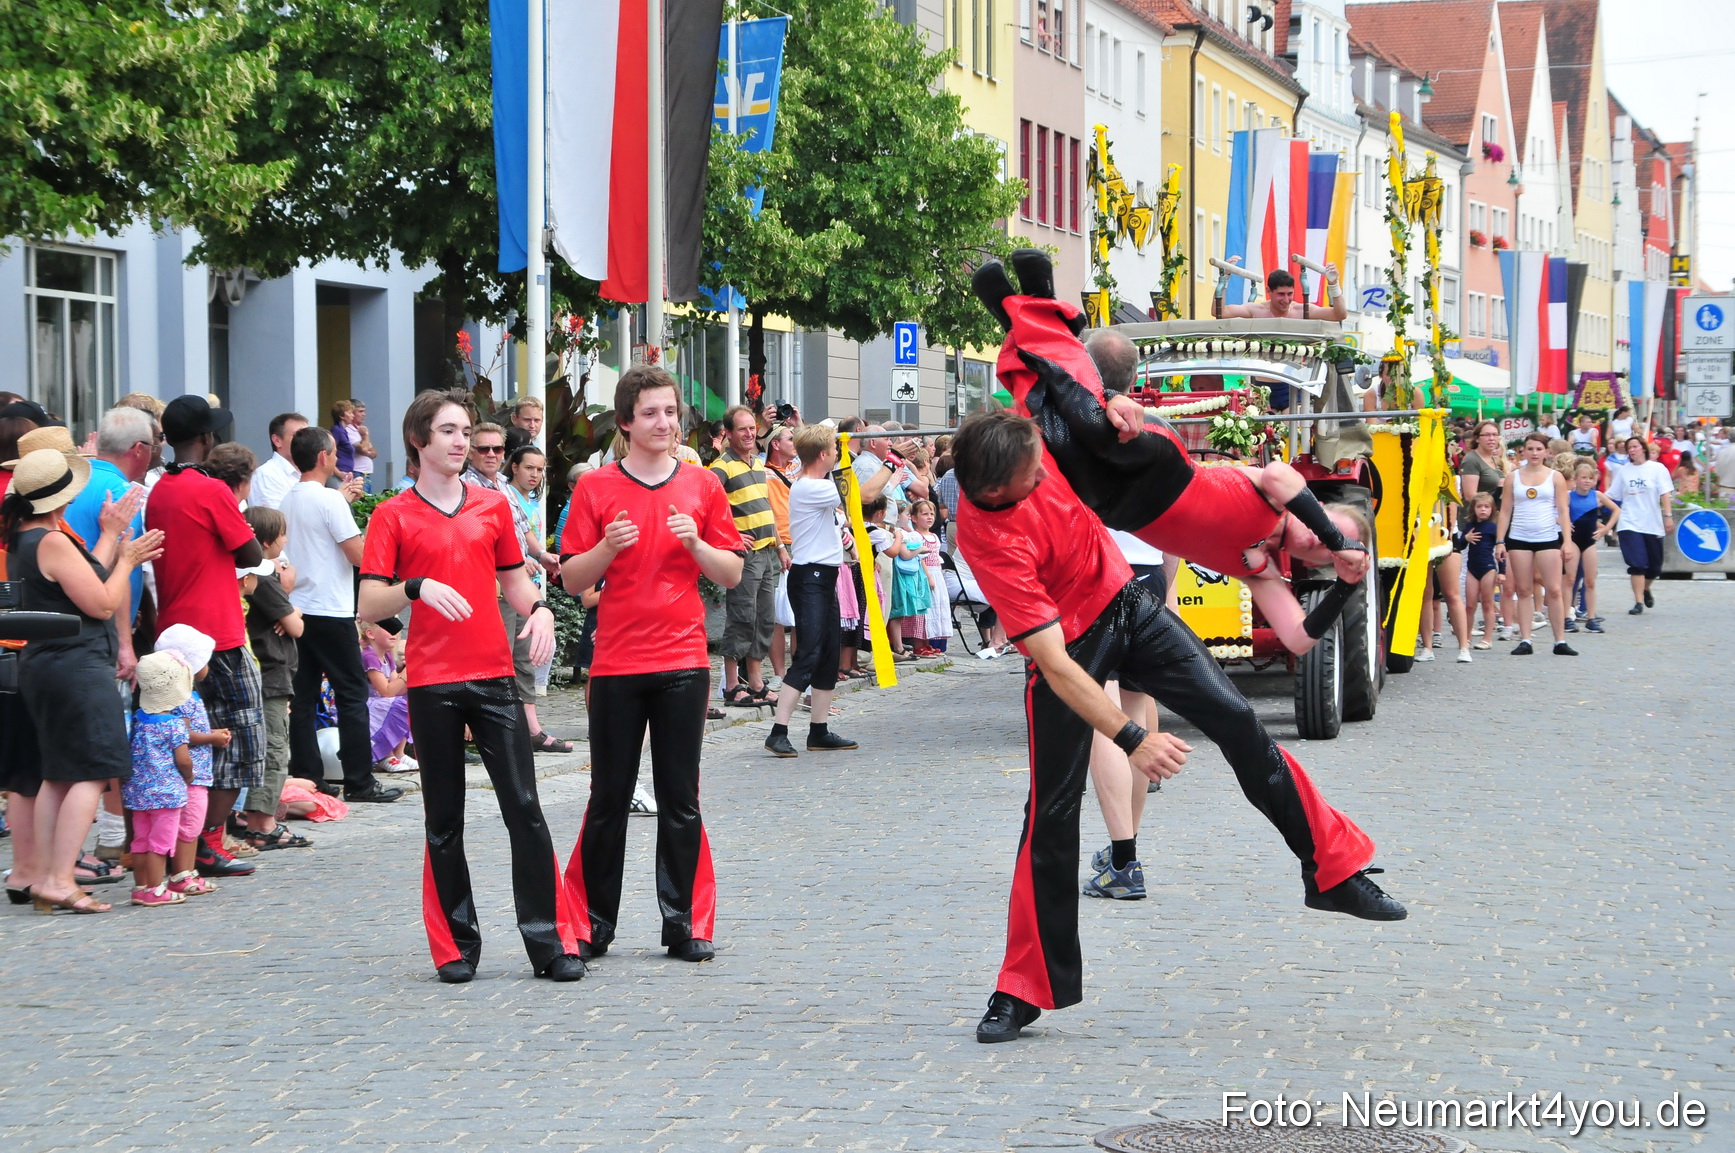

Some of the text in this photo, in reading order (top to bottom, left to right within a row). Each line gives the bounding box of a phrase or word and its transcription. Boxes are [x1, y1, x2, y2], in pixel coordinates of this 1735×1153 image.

[900, 328, 912, 359] P
[1696, 336, 1723, 345] ZONE
[1584, 392, 1613, 404] BSC
[1504, 418, 1529, 430] BSC
